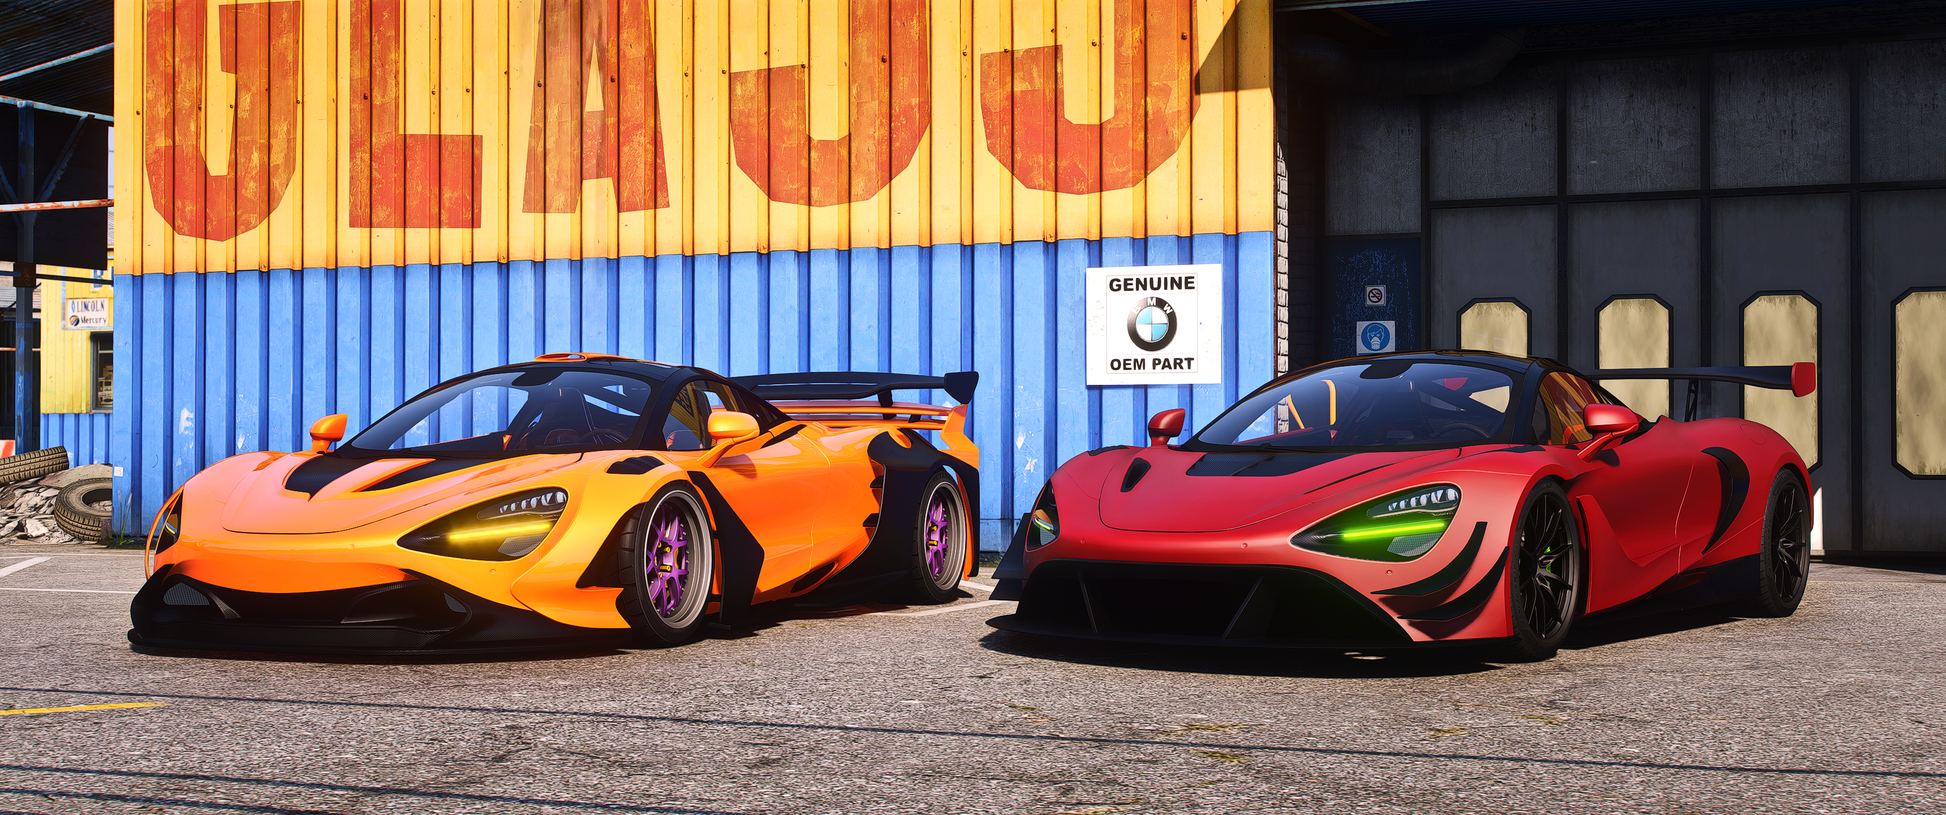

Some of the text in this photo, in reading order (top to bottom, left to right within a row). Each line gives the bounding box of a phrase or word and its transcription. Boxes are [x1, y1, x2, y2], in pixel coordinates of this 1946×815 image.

[1109, 276, 1195, 292] GENUINE
[77, 300, 105, 312] LINCOLN
[1132, 297, 1173, 315] BMW
[80, 316, 107, 326] Mercury
[1110, 357, 1195, 371] OEM PART
